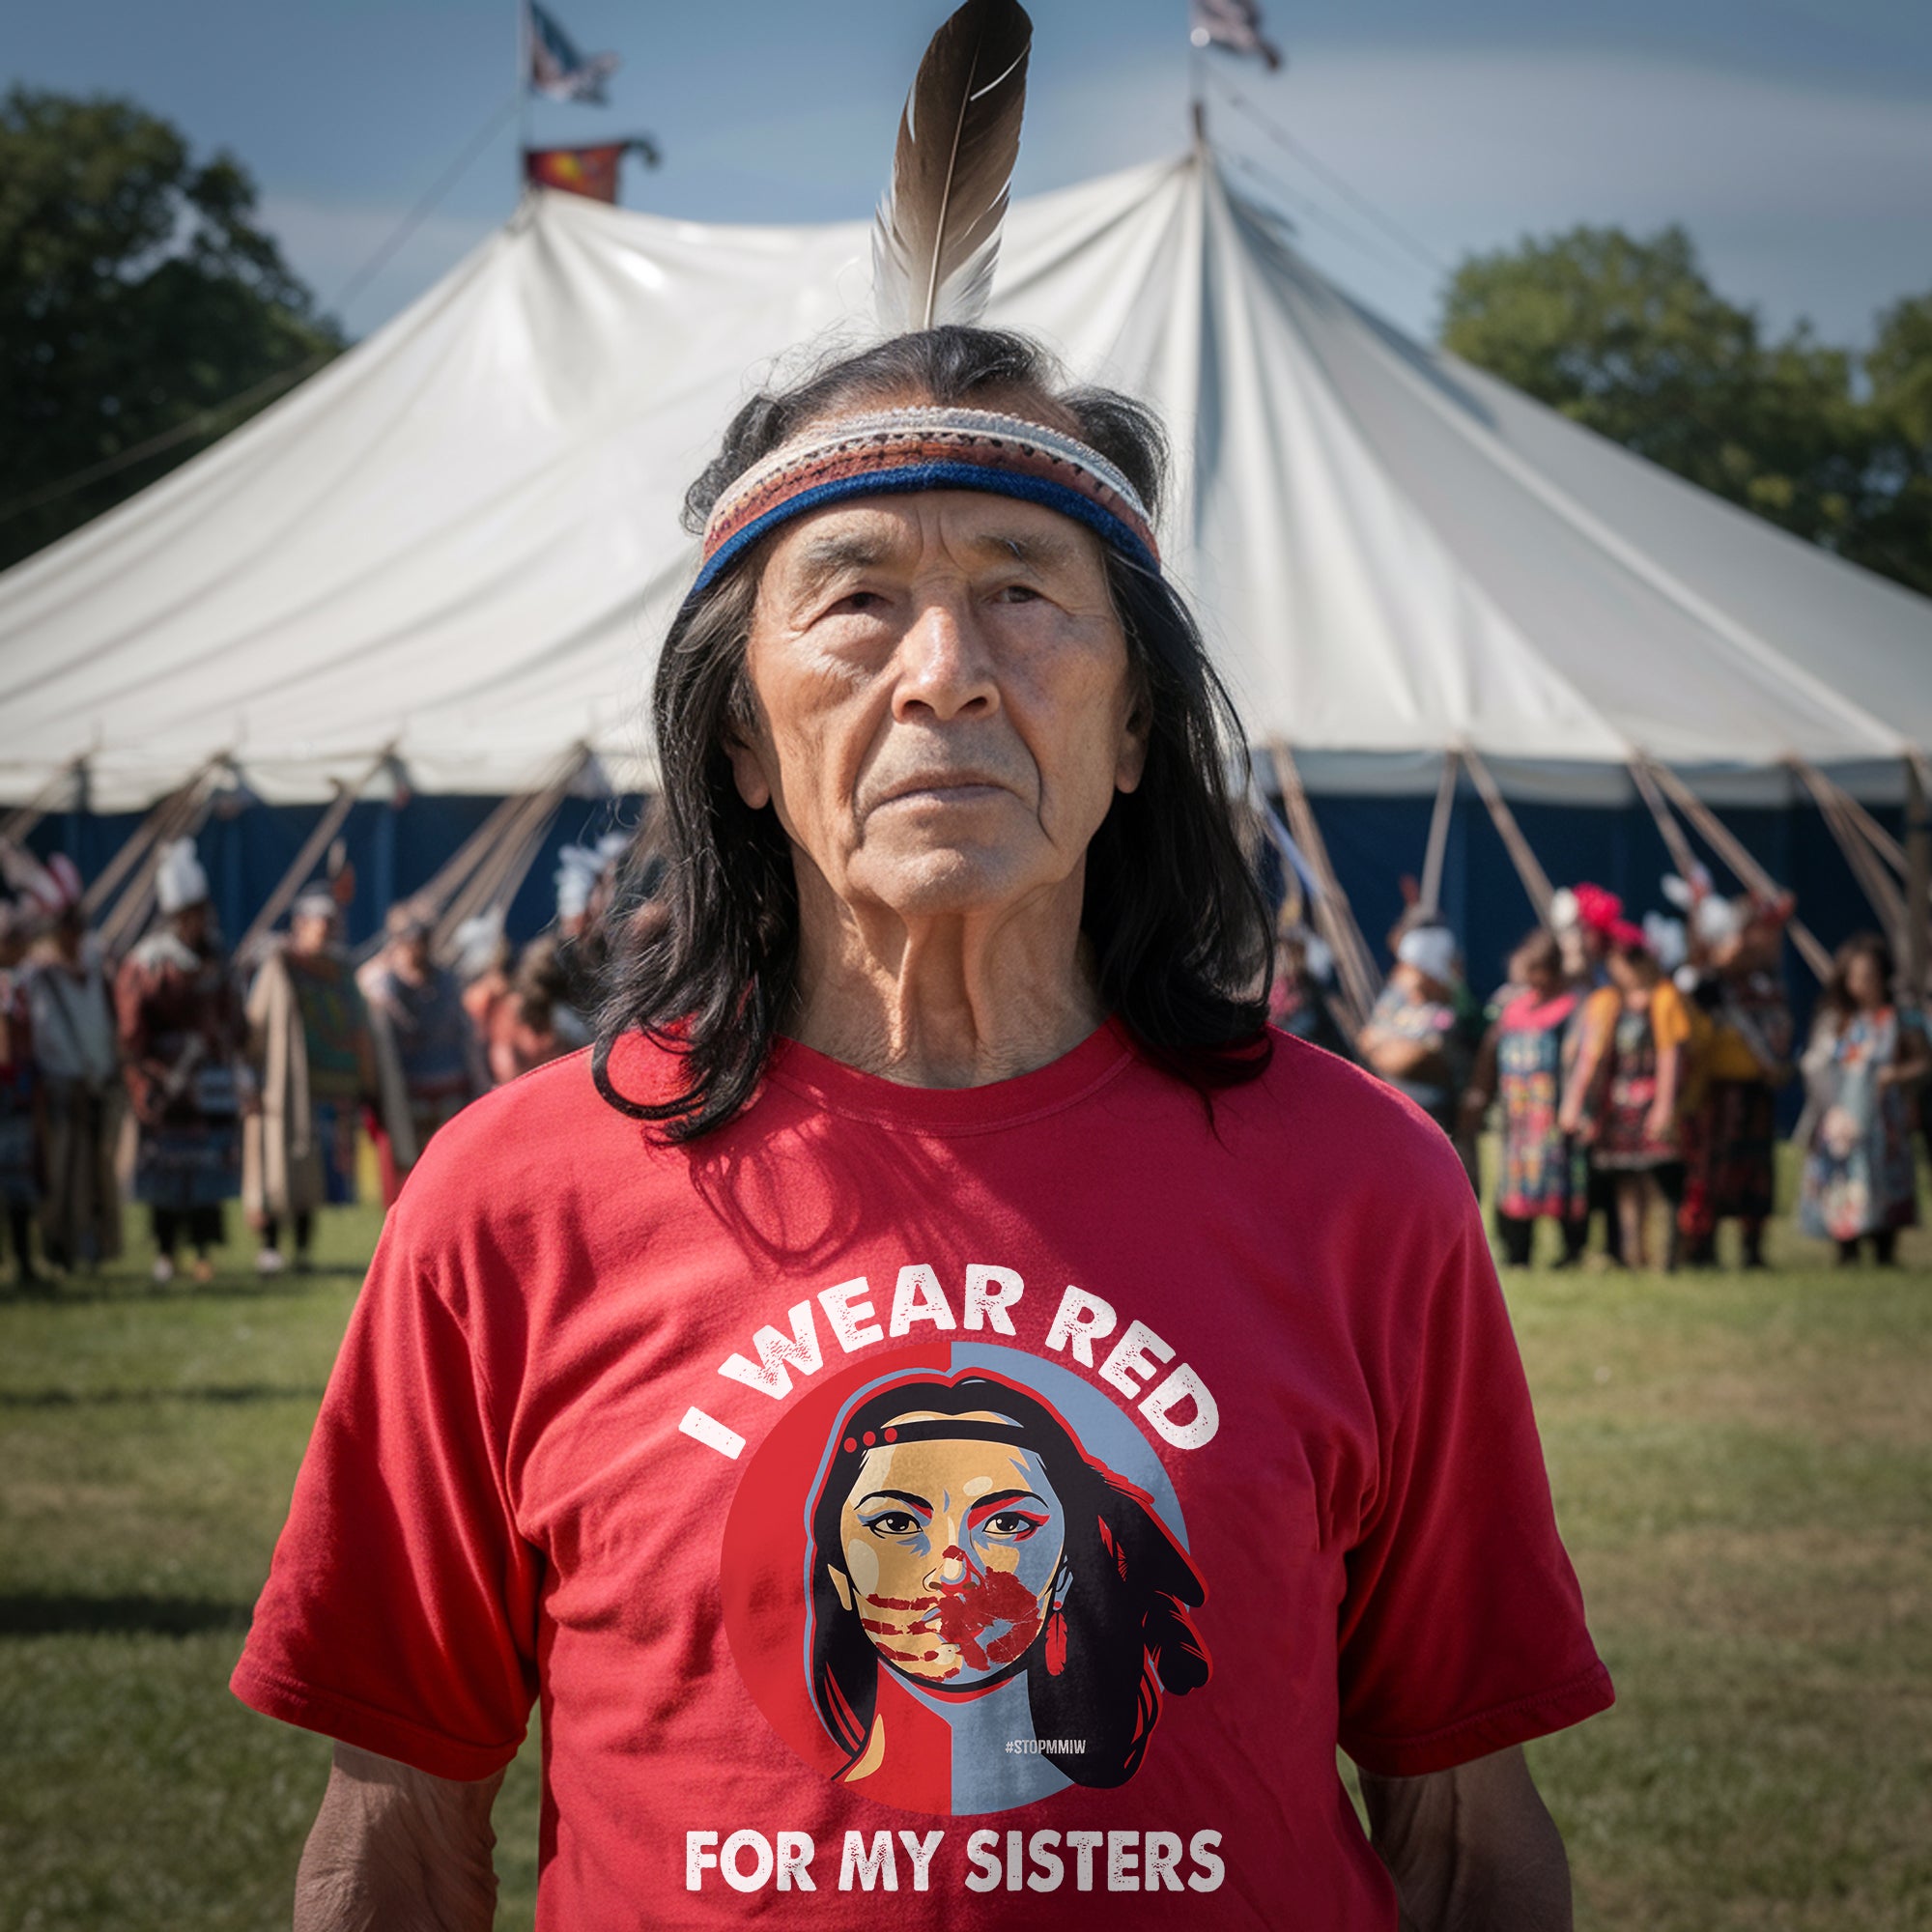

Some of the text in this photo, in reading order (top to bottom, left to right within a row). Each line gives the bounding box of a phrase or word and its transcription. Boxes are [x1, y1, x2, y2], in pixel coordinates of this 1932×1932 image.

[677, 1263, 1221, 1460] I WEAR RED
[1005, 1738, 1087, 1755] #STOPMMIW
[685, 1828, 1226, 1894] FOR MY SISTERS
